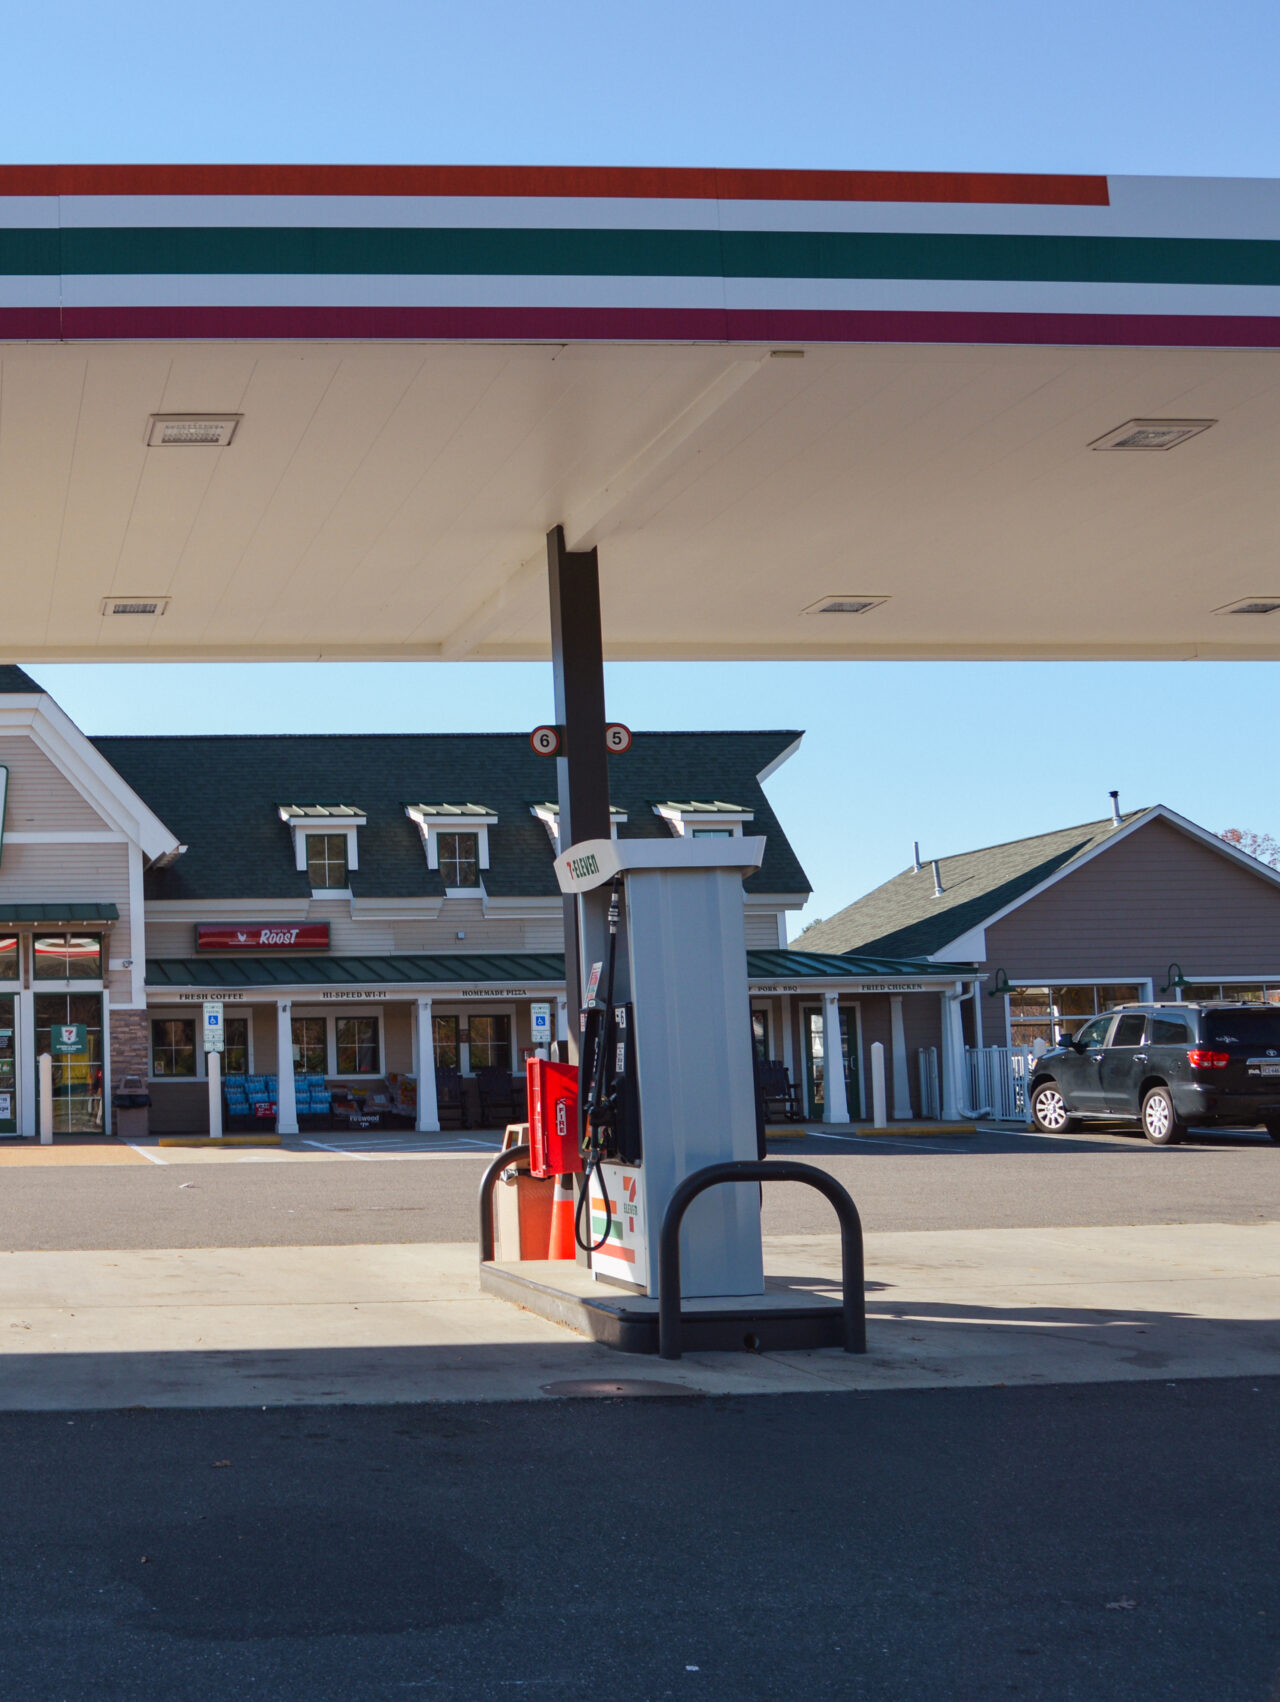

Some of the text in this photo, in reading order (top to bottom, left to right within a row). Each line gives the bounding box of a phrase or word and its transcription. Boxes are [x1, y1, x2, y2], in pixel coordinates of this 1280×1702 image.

[540, 734, 550, 748] 6
[612, 732, 622, 745] 5
[260, 929, 299, 944] ROOST
